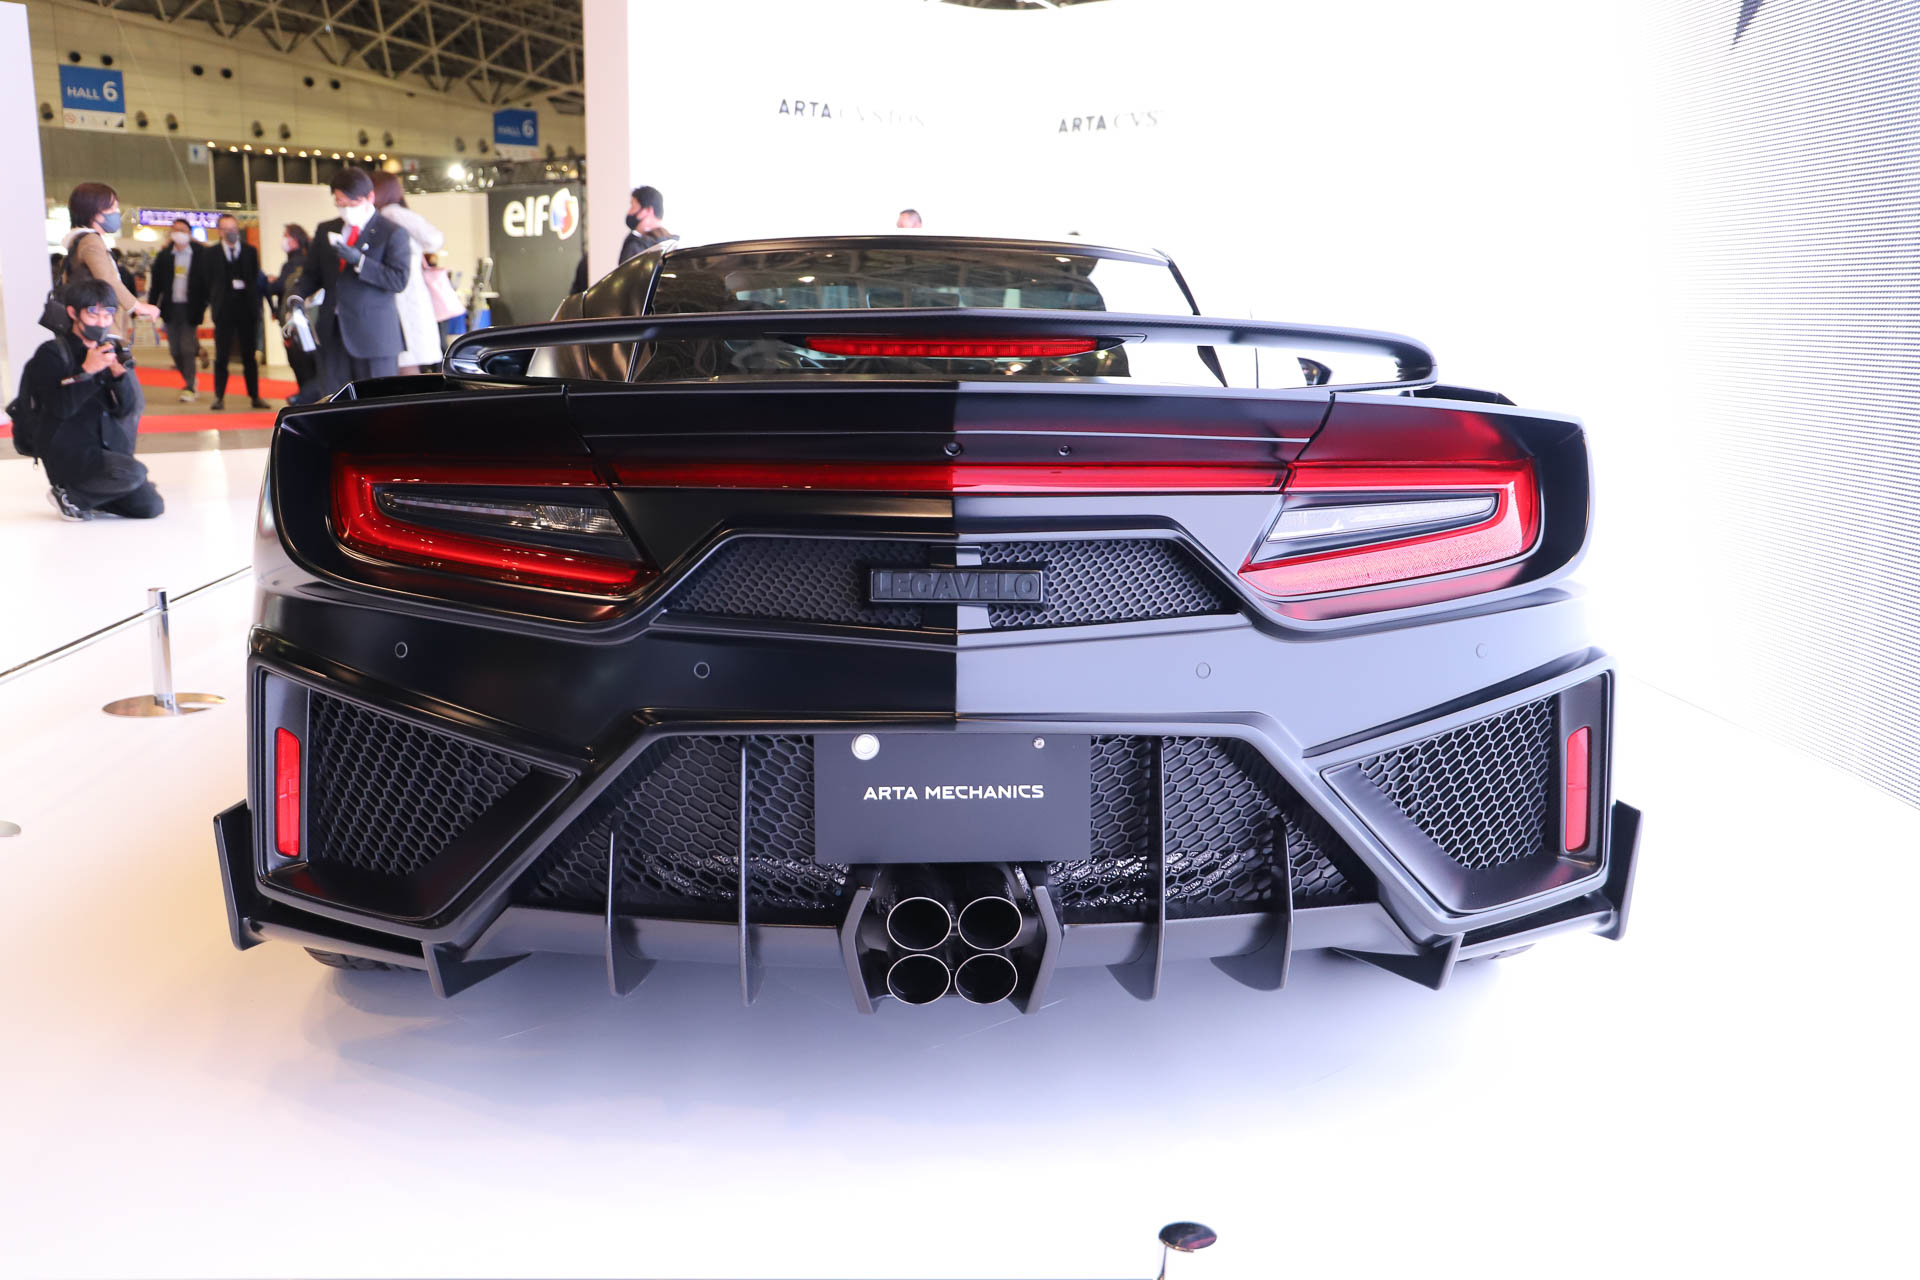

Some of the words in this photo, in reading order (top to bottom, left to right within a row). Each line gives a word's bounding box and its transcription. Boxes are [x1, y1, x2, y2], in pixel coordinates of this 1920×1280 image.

[66, 84, 101, 101] HALL
[103, 80, 118, 103] 6
[778, 97, 832, 119] ARTA
[522, 119, 534, 139] 6
[1058, 114, 1107, 134] ARTA
[503, 194, 551, 238] elf
[874, 571, 1040, 600] LEGAVELO
[863, 785, 918, 801] ARTA
[925, 784, 1044, 800] MECHANICS
